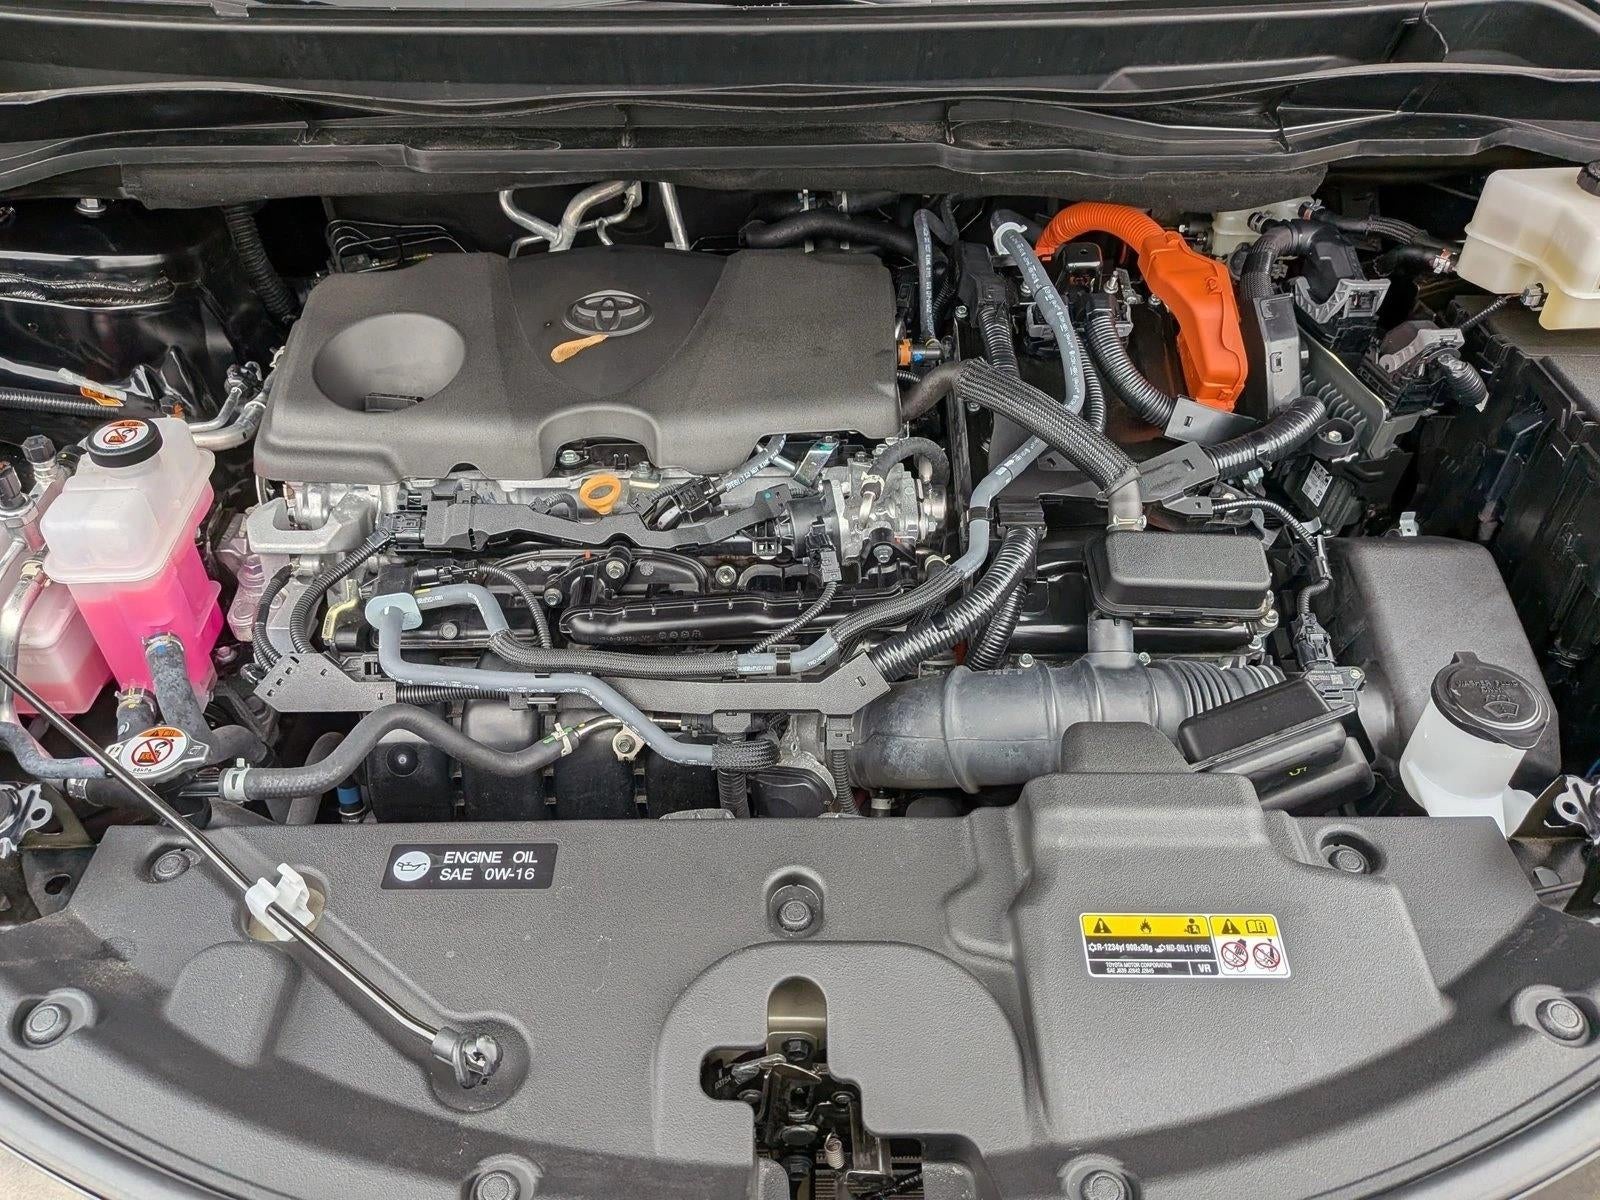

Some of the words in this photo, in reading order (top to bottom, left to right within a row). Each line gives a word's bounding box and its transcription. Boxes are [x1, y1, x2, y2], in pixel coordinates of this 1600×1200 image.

[443, 850, 503, 864] ENGINE
[512, 850, 538, 864] OIL
[439, 867, 474, 881] SAE
[484, 867, 536, 881] 0W-16
[1140, 961, 1173, 969] CORPORATION
[1197, 963, 1212, 973] VR
